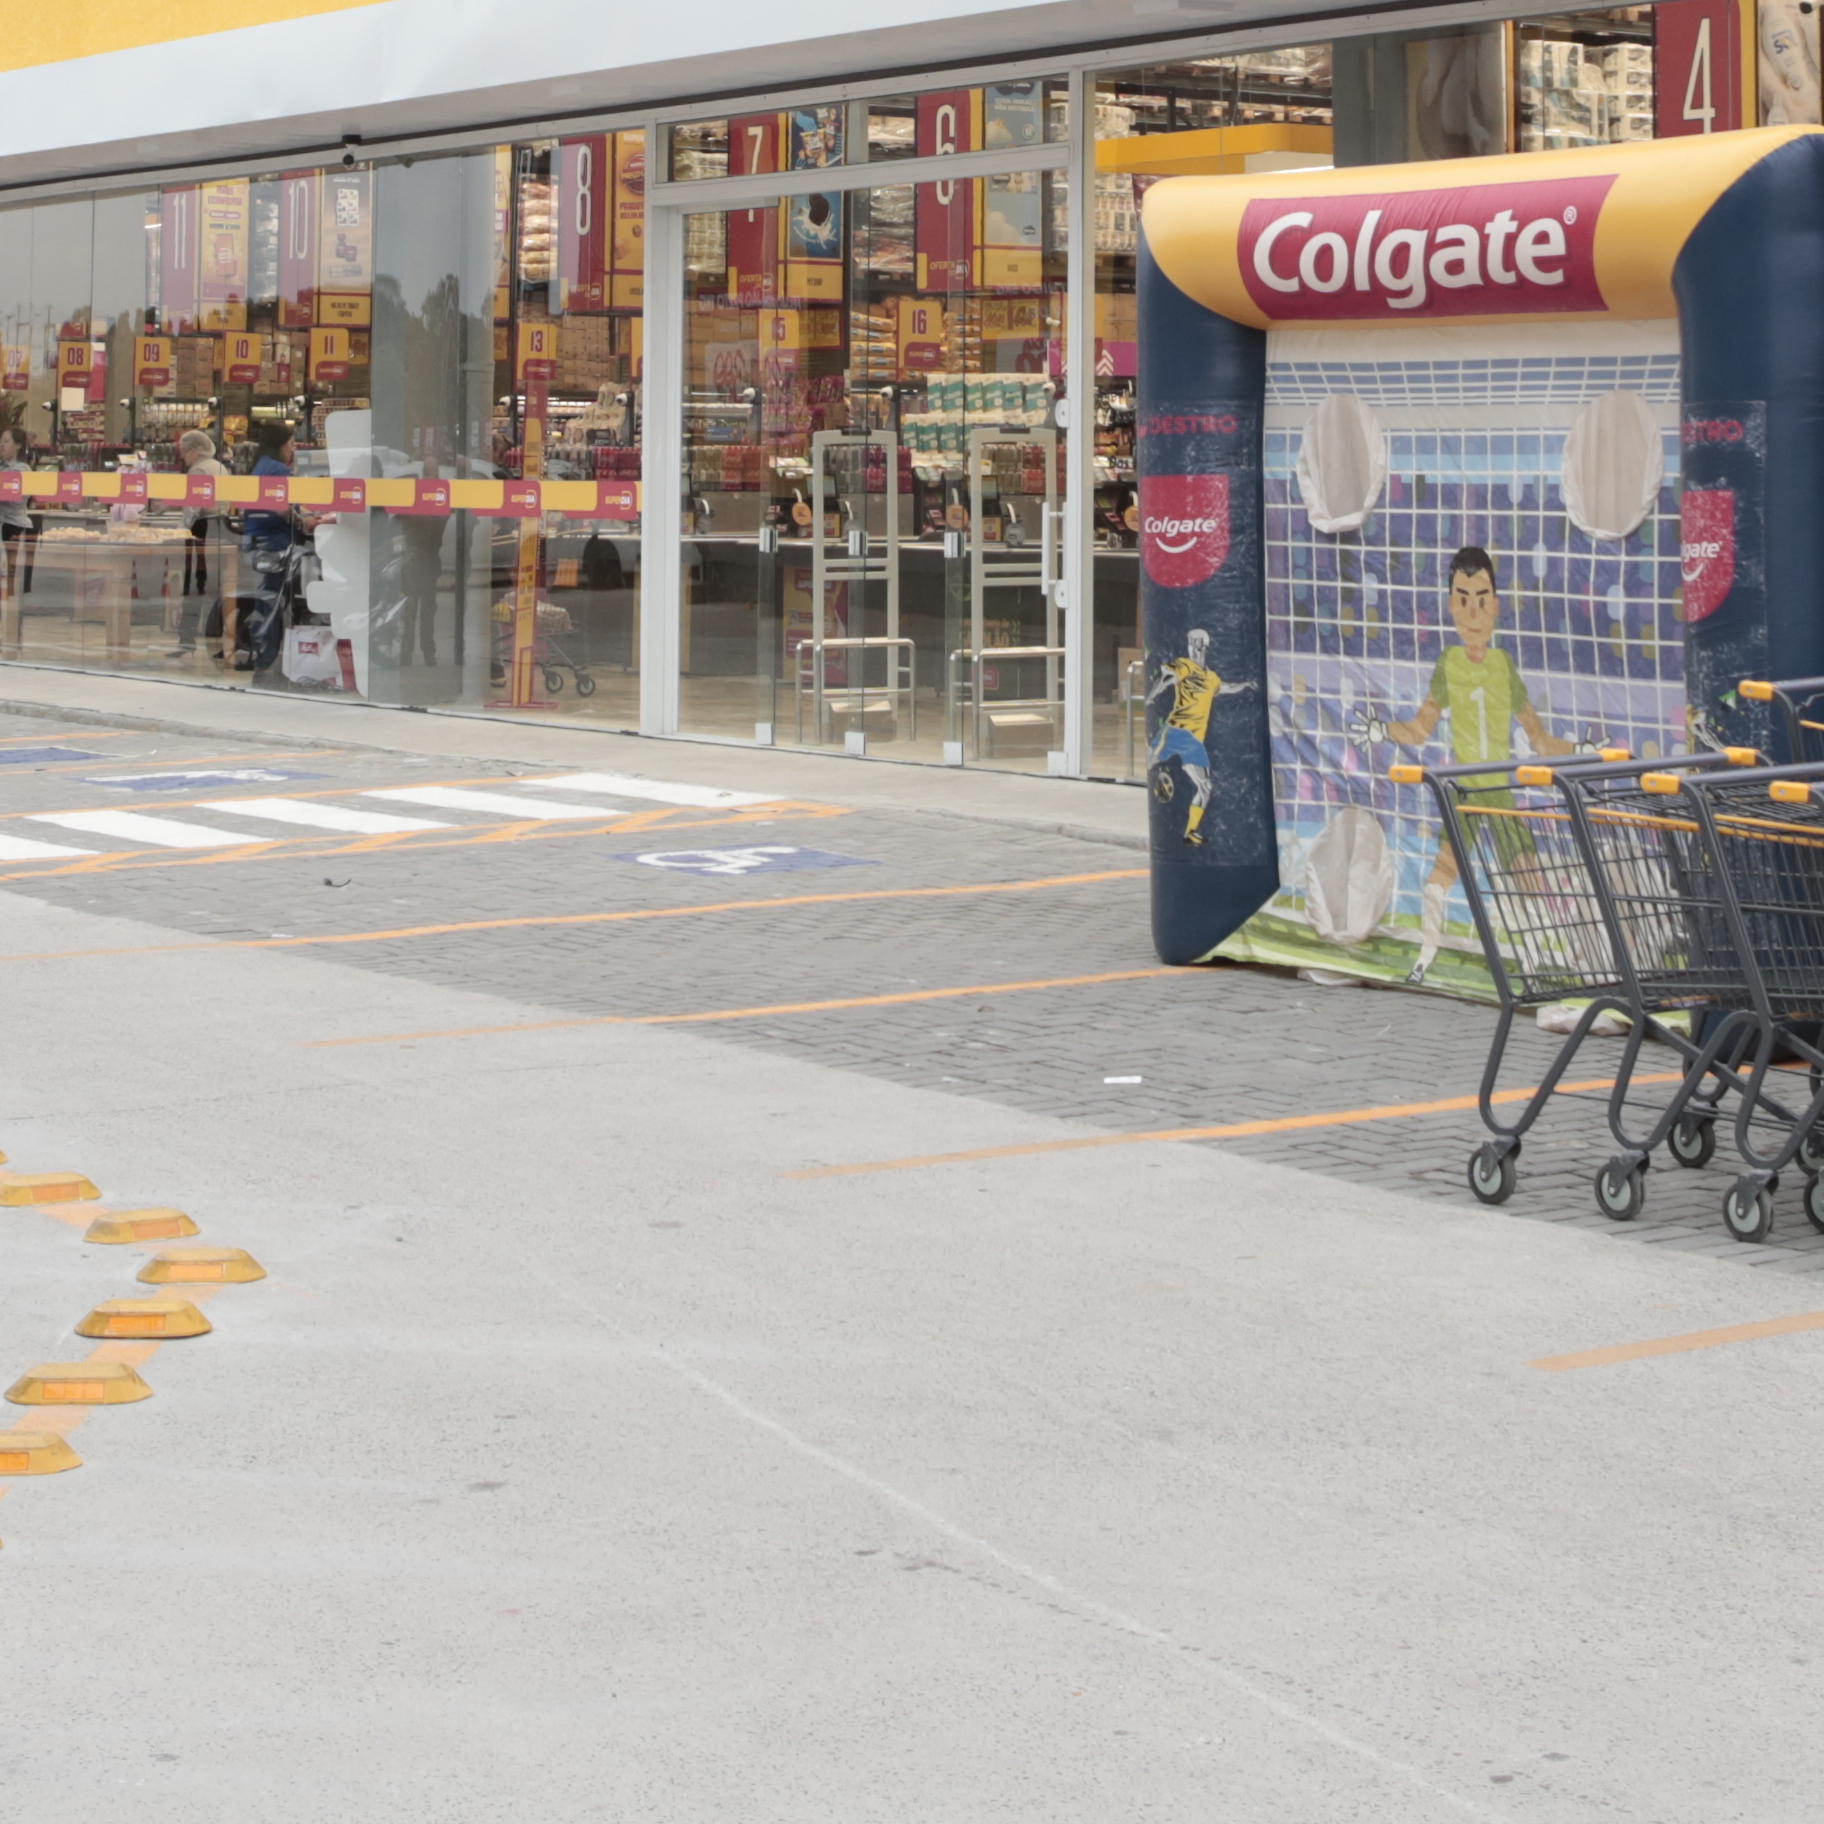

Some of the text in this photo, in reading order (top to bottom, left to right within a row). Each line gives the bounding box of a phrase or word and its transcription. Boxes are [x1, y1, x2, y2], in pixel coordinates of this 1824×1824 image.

[1682, 17, 1717, 134] 4
[575, 144, 592, 236] 8
[911, 308, 927, 335] 16
[235, 339, 249, 359] 10
[530, 329, 544, 353] 13
[66, 346, 85, 366] 08
[142, 343, 160, 362] 09
[1148, 414, 1239, 436] DESTRO
[1144, 516, 1217, 538] Colgate
